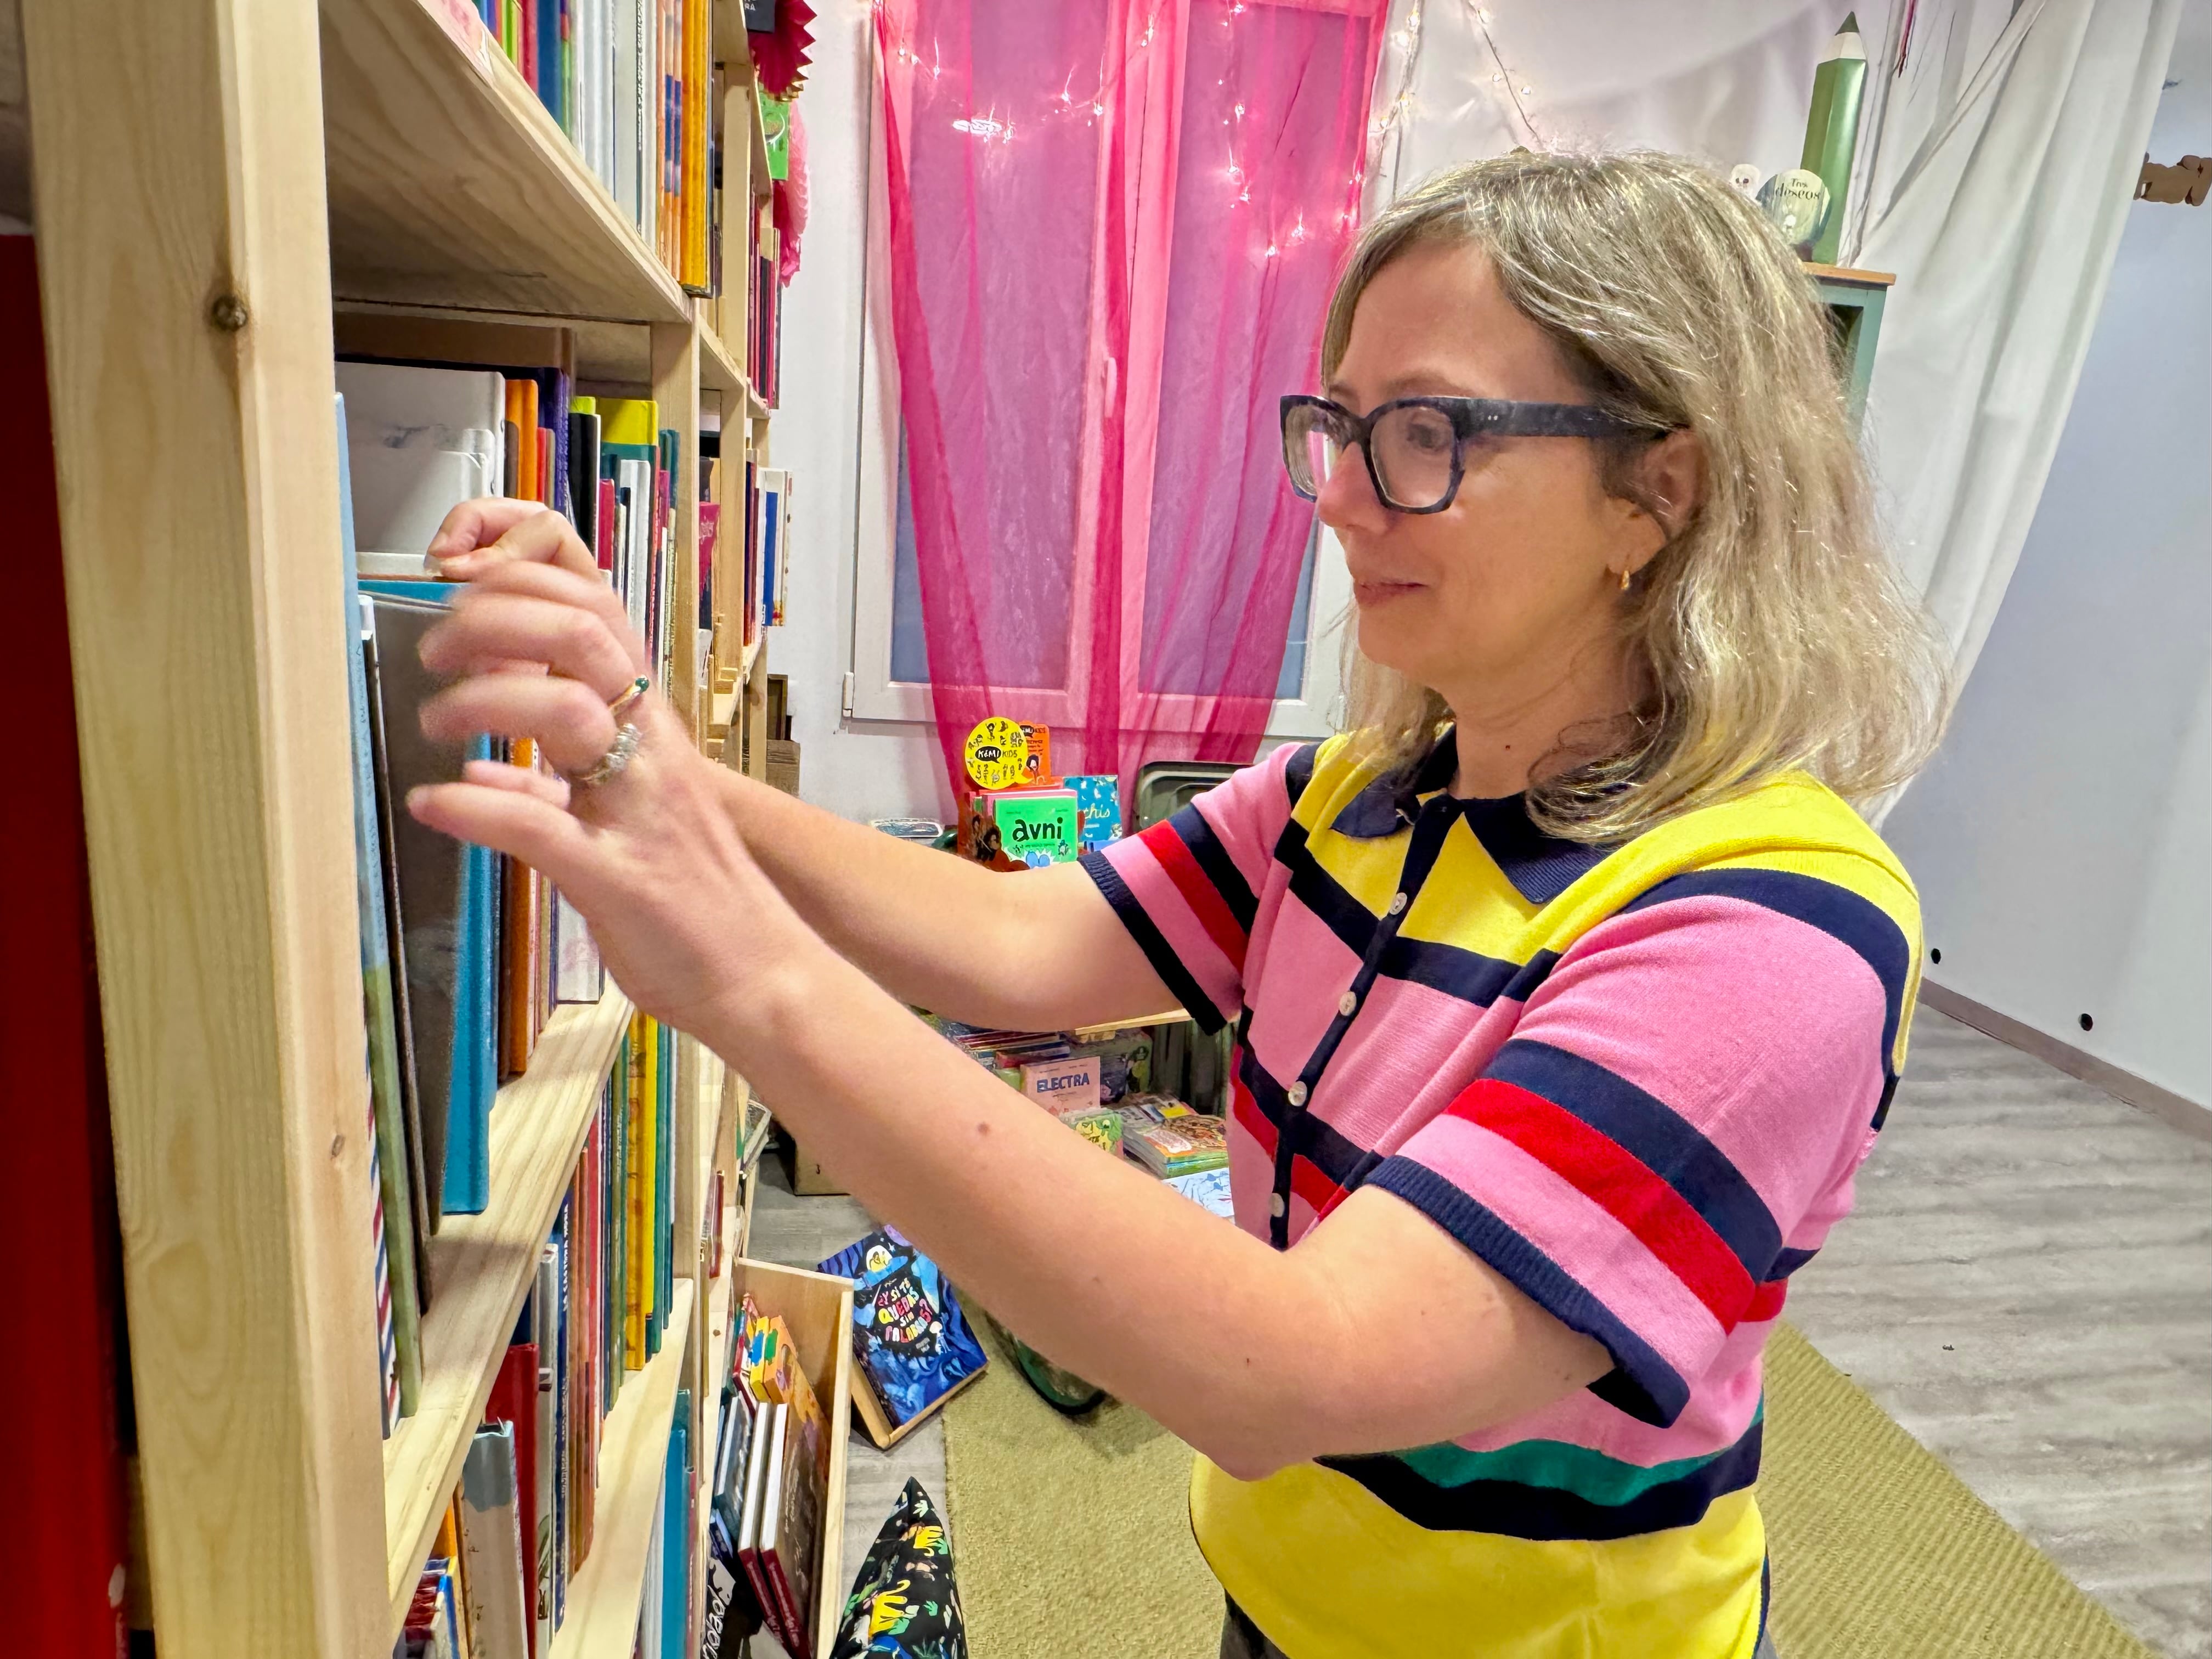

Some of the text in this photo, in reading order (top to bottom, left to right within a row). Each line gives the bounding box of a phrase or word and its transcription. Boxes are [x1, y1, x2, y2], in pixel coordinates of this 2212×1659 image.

[1775, 182, 1821, 200] deseos
[978, 749, 1000, 758] KEMI
[1012, 817, 1063, 842] avni
[1037, 1073, 1090, 1093] ELECTRA
